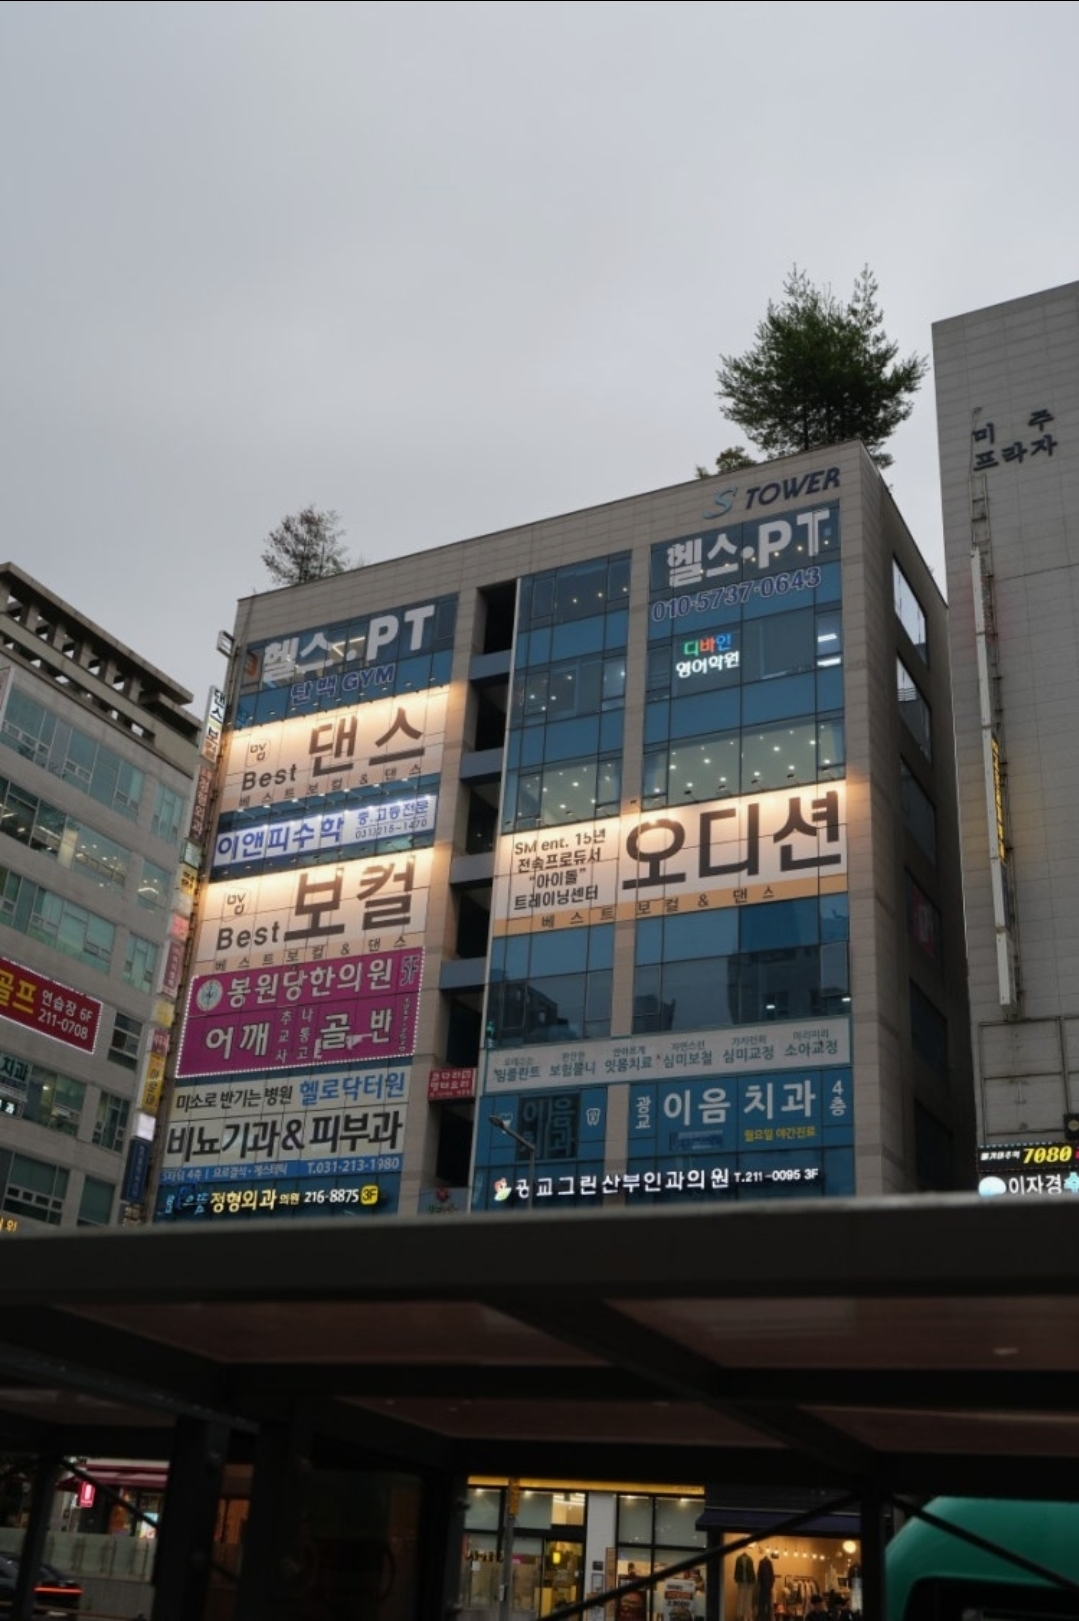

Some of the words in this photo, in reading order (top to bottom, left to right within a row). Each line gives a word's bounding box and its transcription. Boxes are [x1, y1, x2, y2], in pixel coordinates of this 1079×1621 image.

[972, 409, 1054, 445] 미주
[973, 434, 1058, 471] 프라자
[745, 467, 840, 509] TOWER
[684, 633, 732, 656] 디바인
[343, 663, 396, 691] GYM
[676, 651, 739, 678] 영어학원
[309, 707, 425, 777] 댄스
[242, 764, 296, 791] Best
[218, 817, 344, 860] 이앤피수학
[514, 840, 537, 856] SM
[541, 837, 569, 852] ent.
[622, 791, 841, 890] 오디션
[518, 850, 601, 874] 전속프로듀서
[284, 857, 416, 942] 보컬
[514, 885, 598, 911] 트레이닝센터
[541, 906, 616, 929] 베스트
[636, 899, 679, 915] 보컬
[698, 895, 708, 907] &
[733, 886, 775, 902] 댄스
[216, 921, 280, 951] Best
[368, 935, 406, 952] 댄스
[227, 958, 392, 1009] 봉원당한의원
[42, 989, 77, 1017] 연습장
[79, 1008, 93, 1023] 6F
[37, 1008, 88, 1040] 211-0708
[320, 1008, 392, 1050] 골반
[206, 1023, 270, 1059] 어깨
[723, 1046, 774, 1064] 심미교정
[176, 1092, 216, 1112] 미소로
[220, 1088, 261, 1108] 반기는
[264, 1085, 293, 1106] 병원
[663, 1088, 731, 1126] 이음
[743, 1080, 816, 1119] 치과
[1023, 1145, 1073, 1163] 7080
[210, 1189, 277, 1213] 정형외과
[305, 1188, 359, 1204] 216-8875
[362, 1188, 377, 1201] 3F
